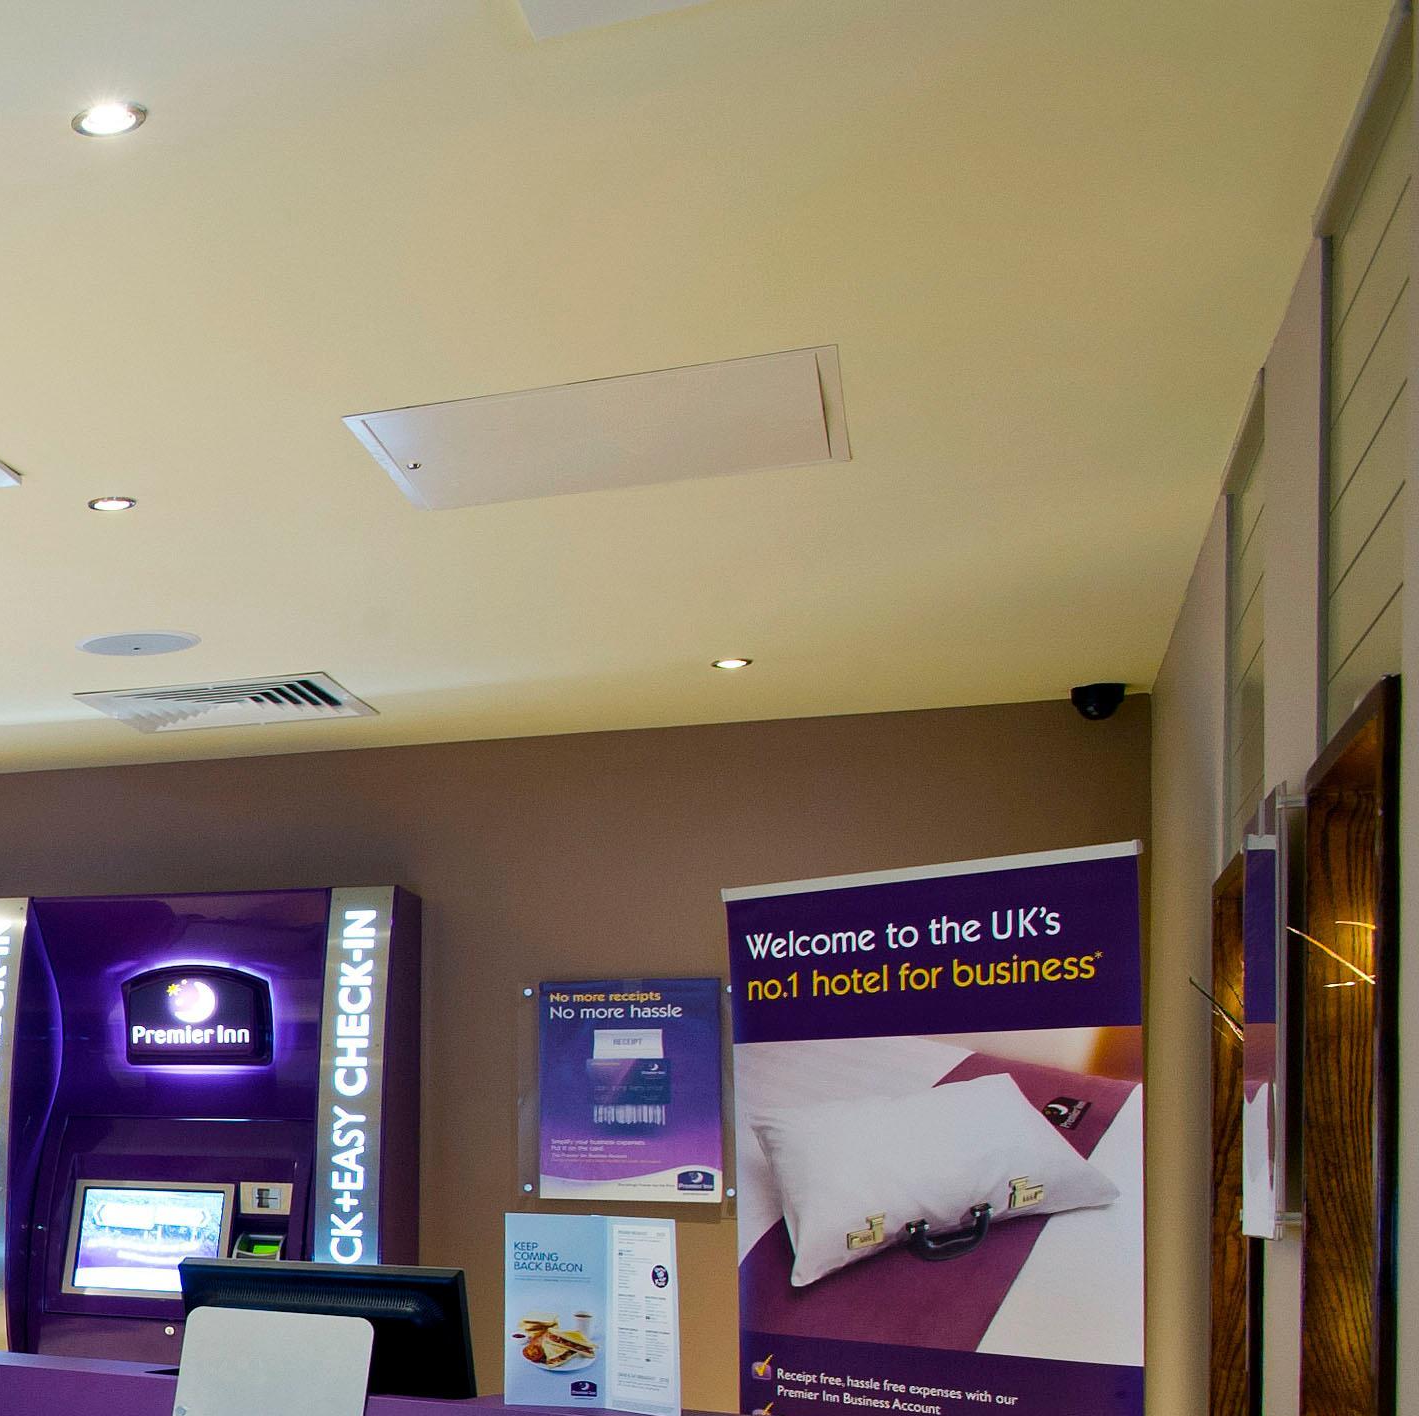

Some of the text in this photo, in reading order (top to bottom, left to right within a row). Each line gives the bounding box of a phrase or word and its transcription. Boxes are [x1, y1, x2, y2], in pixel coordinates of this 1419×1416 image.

[745, 931, 876, 961] Welcome
[885, 922, 919, 950] to
[928, 915, 981, 946] the
[747, 972, 799, 1001] no.1
[812, 964, 890, 997] hotel
[898, 962, 943, 991] for
[549, 991, 662, 1003] No more receipts
[549, 1004, 683, 1020] No more hassle
[131, 1024, 250, 1045] Premier Inn
[329, 909, 377, 1265] CK+EASY CHECK-IN
[513, 1241, 539, 1251] KEEP
[513, 1252, 559, 1262] COMING
[513, 1261, 584, 1273] BACK BACON
[777, 1367, 818, 1386] Receipt
[847, 1375, 881, 1390] hassle
[883, 1379, 906, 1393] free
[909, 1384, 963, 1400] expenses
[965, 1390, 992, 1403] with
[995, 1394, 1019, 1406] our
[777, 1384, 942, 1415] Premier Inn Business Account
